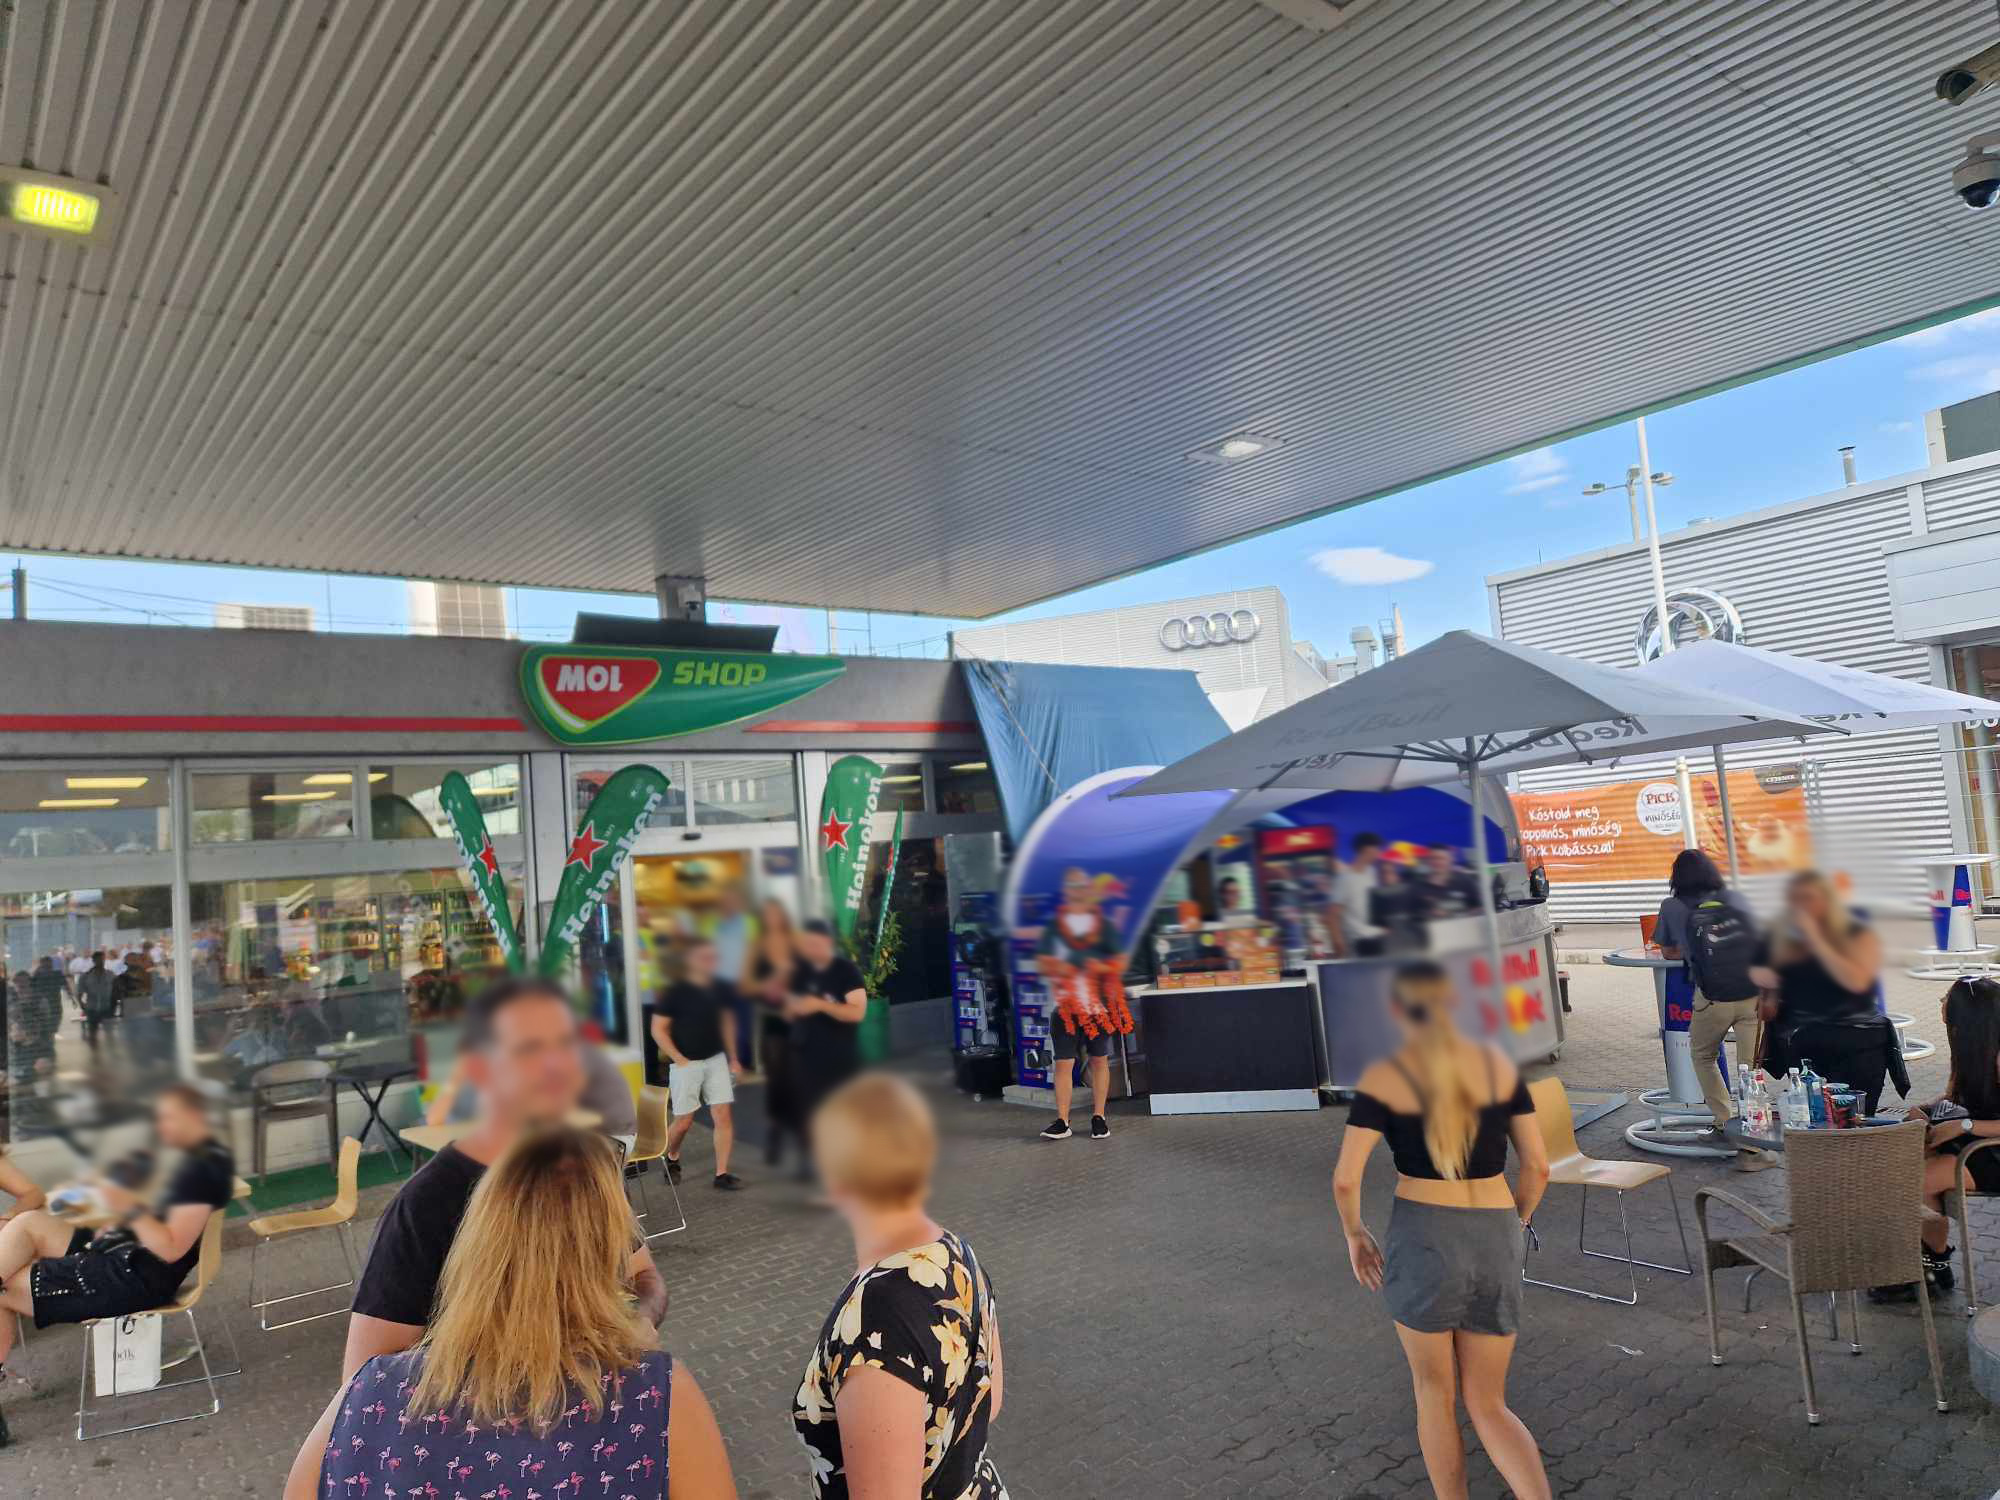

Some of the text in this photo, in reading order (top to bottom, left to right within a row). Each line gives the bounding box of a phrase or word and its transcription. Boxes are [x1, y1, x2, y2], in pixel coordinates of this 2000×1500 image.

[556, 661, 767, 692] MOL SHOP
[1646, 792, 1675, 805] PICK
[1574, 806, 1600, 821] meg
[1572, 821, 1622, 838] minőségi
[846, 777, 881, 909] Heineken
[558, 791, 663, 944] Heineken
